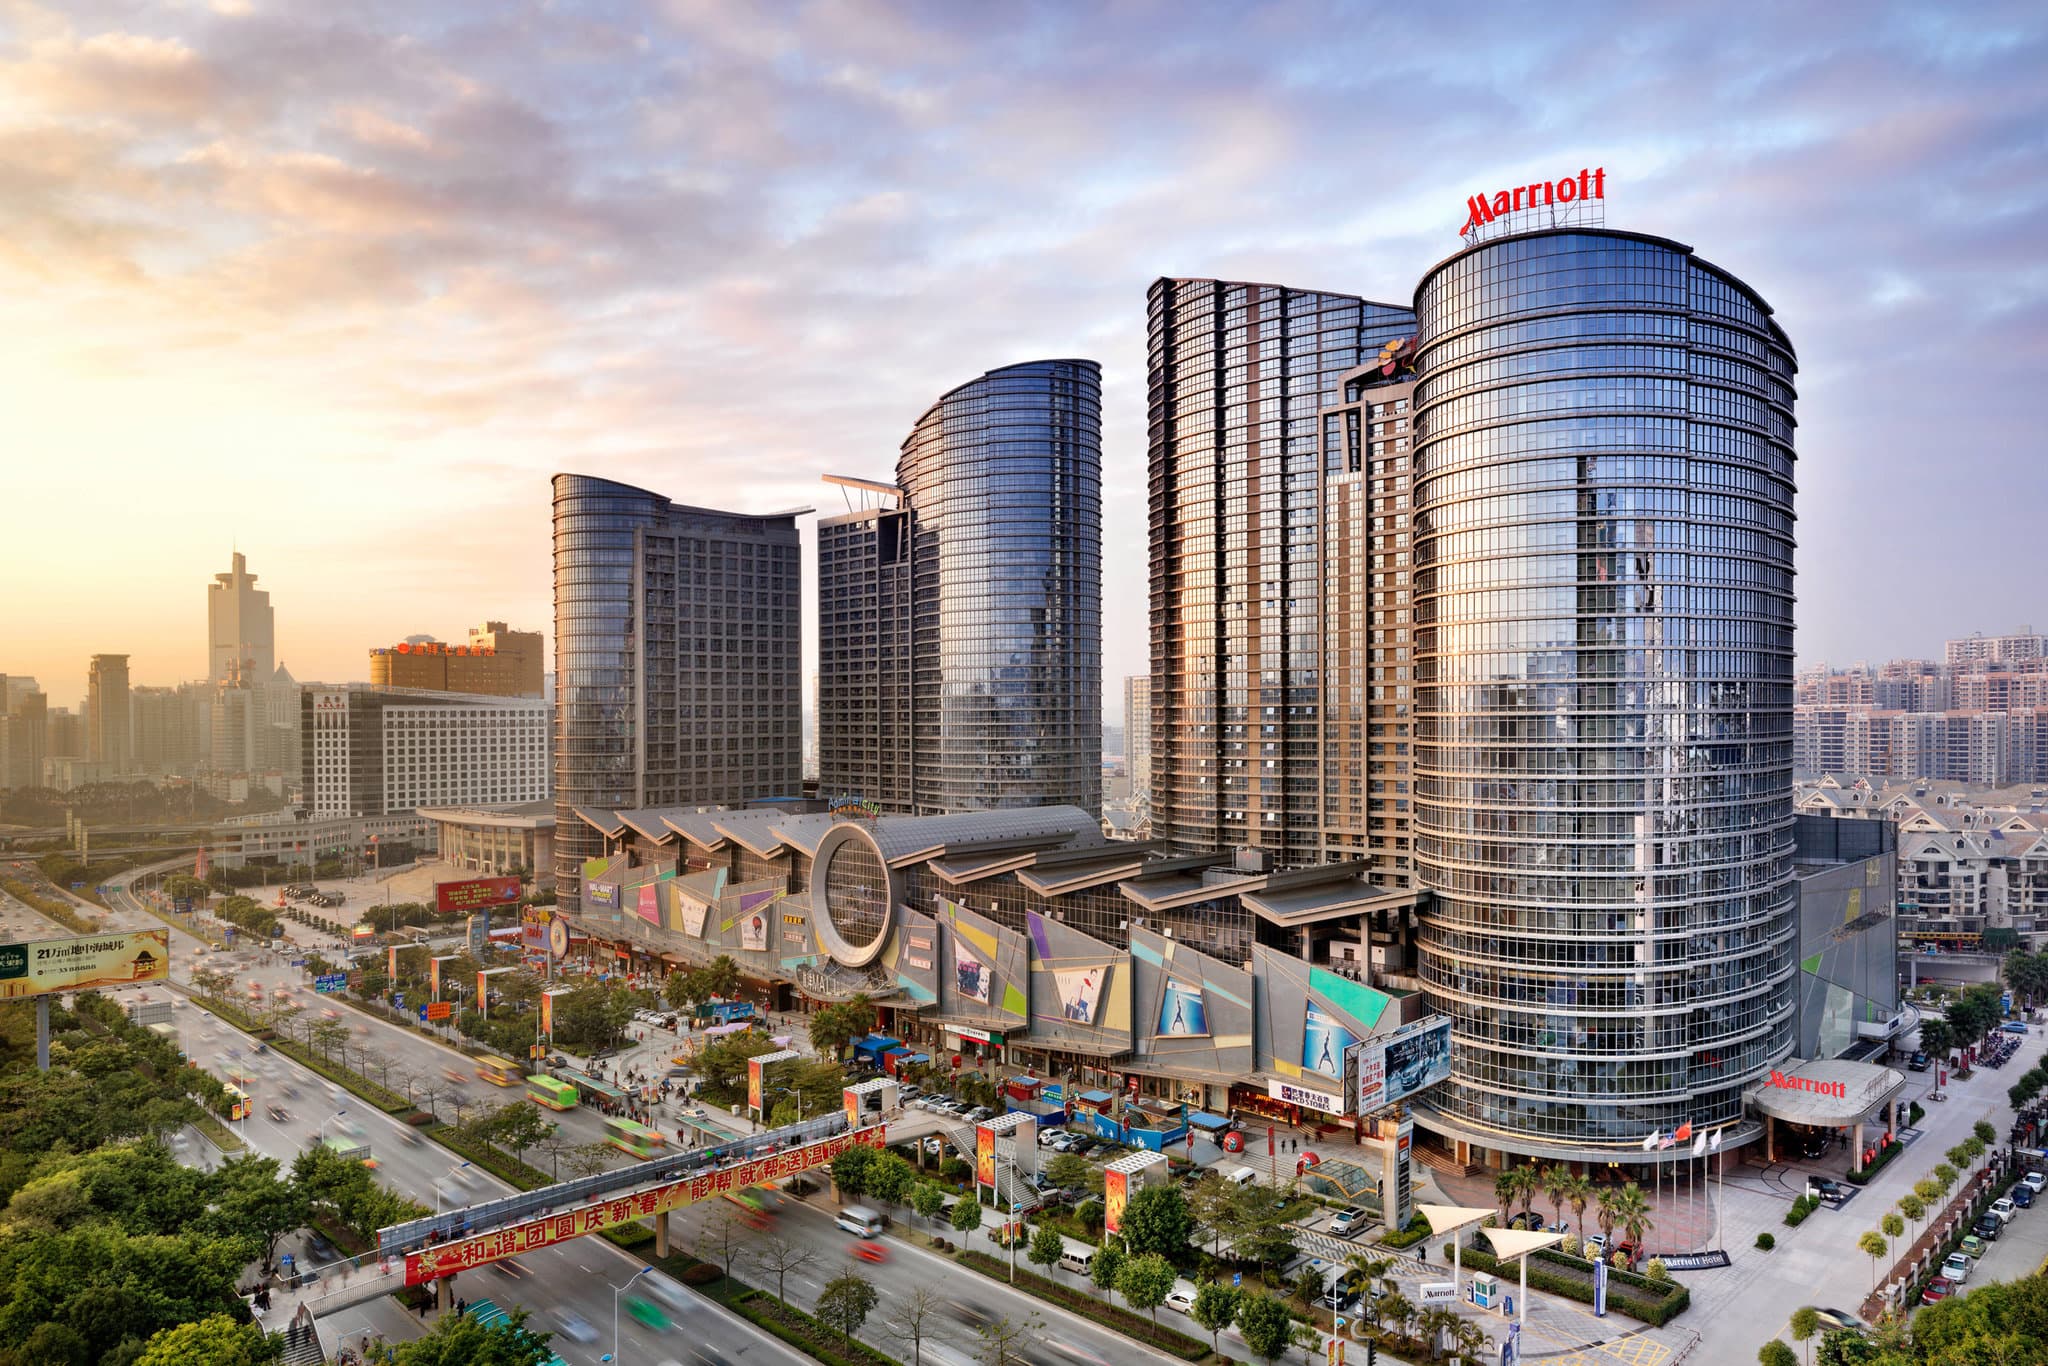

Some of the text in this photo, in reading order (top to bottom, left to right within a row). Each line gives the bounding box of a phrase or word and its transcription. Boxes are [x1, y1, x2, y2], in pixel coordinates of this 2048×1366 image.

[1459, 167, 1606, 236] Marriott
[1763, 1069, 1846, 1099] Marriott
[1305, 1099, 1330, 1111] STORES
[1664, 1254, 1724, 1267] Marriott Hotel
[1425, 1289, 1455, 1299] Marriott
